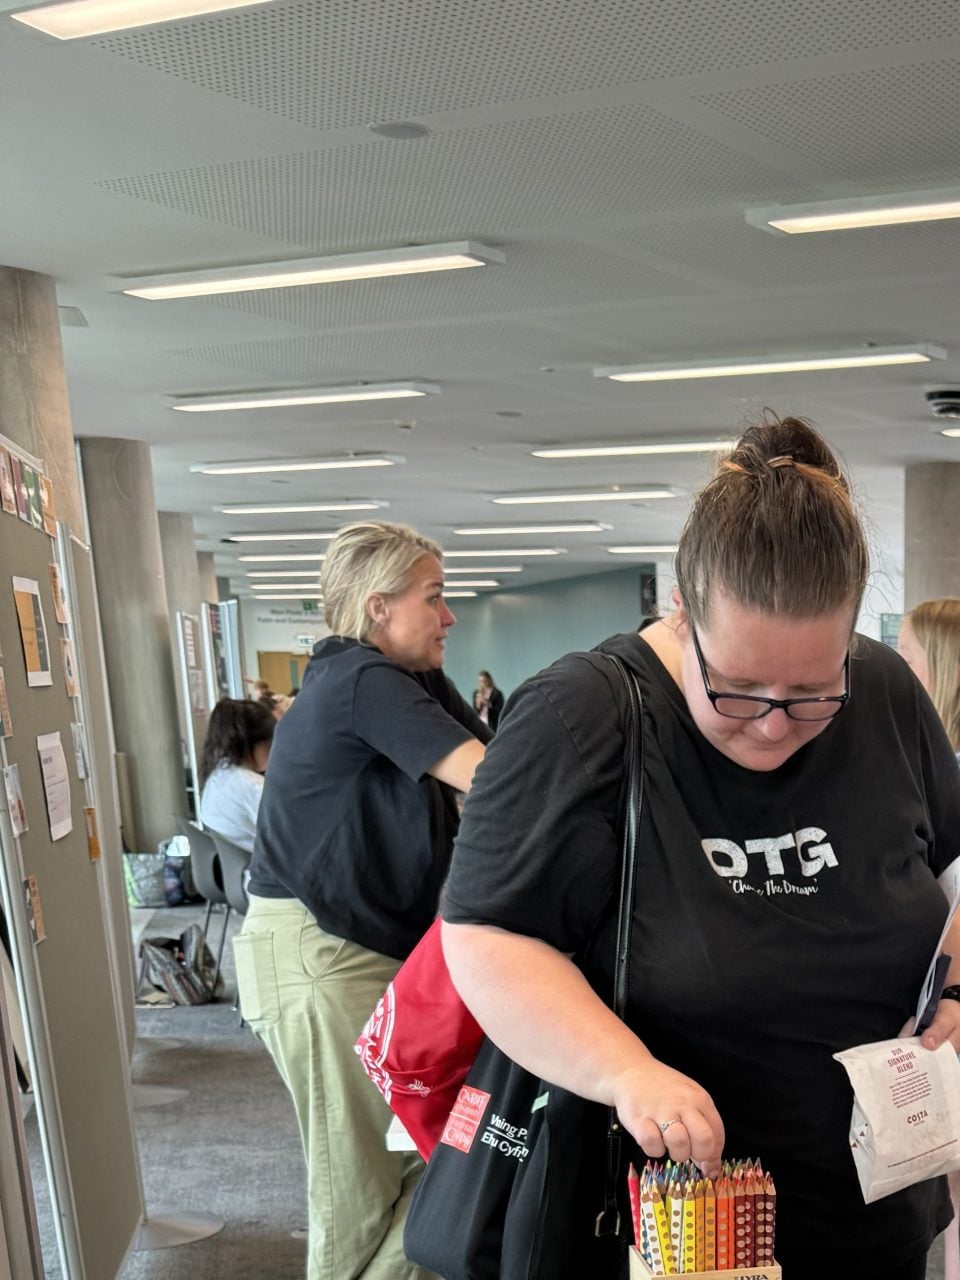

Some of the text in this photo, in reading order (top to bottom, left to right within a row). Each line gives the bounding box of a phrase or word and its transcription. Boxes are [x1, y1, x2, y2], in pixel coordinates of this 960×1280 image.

[887, 1051, 916, 1068] SIGNATURE
[896, 1061, 914, 1074] BLEND
[907, 1109, 928, 1124] COSTA
